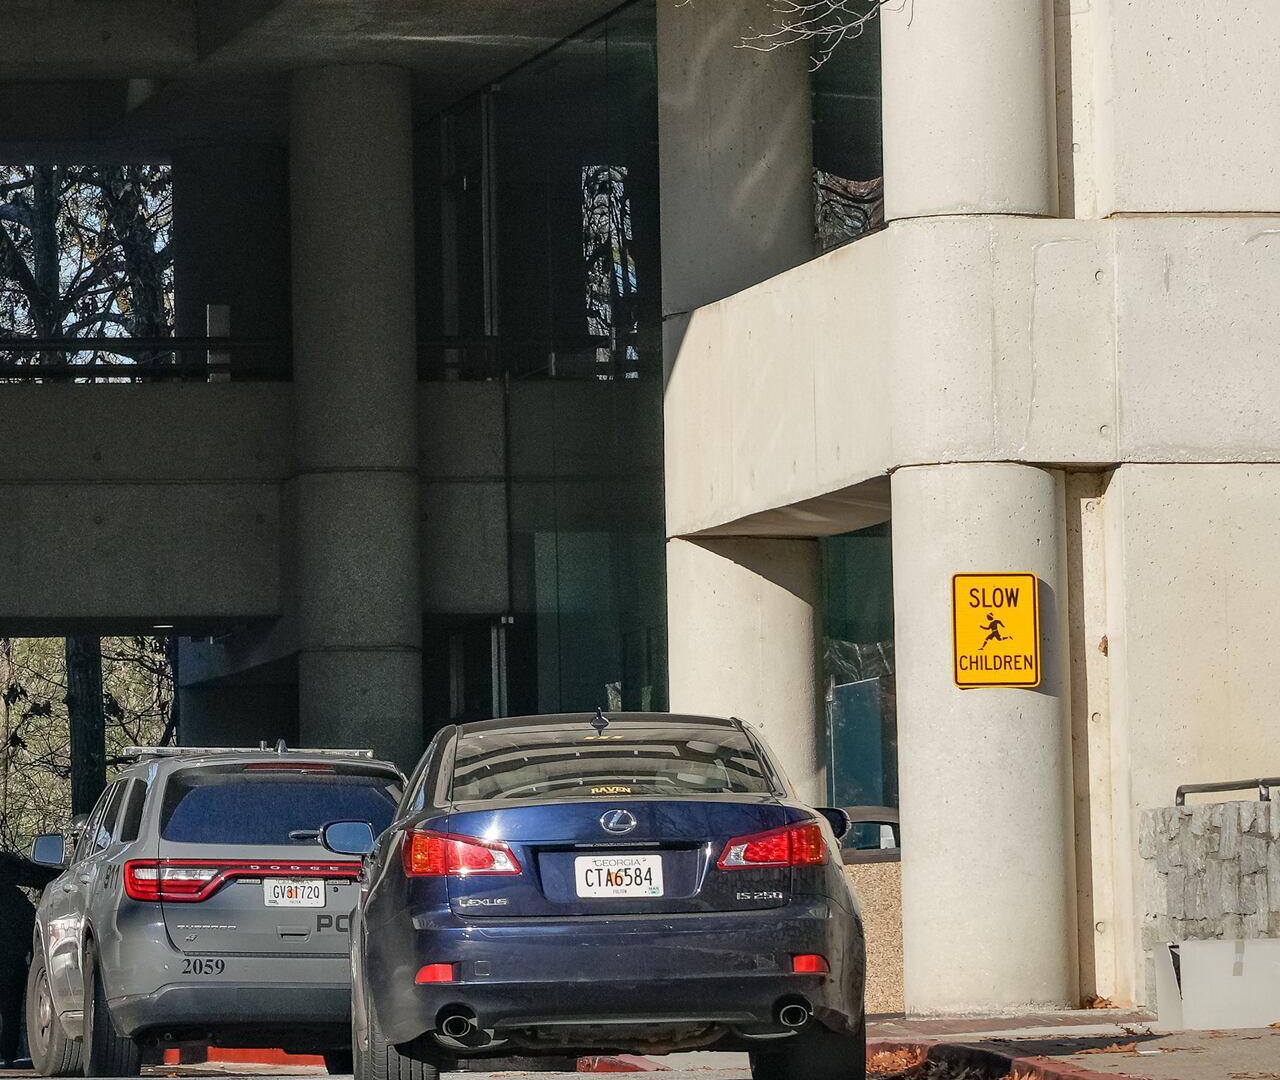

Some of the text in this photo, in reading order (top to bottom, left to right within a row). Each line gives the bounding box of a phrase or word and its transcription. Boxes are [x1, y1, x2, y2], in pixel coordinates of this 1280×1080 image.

[969, 588, 1019, 608] SLOW
[959, 655, 1033, 671] CHILDREN
[594, 859, 641, 867] GEORGIA
[585, 866, 653, 888] CTA6584
[459, 898, 507, 907] LEXUS
[736, 891, 784, 900] IS 250
[181, 958, 225, 976] 2059
